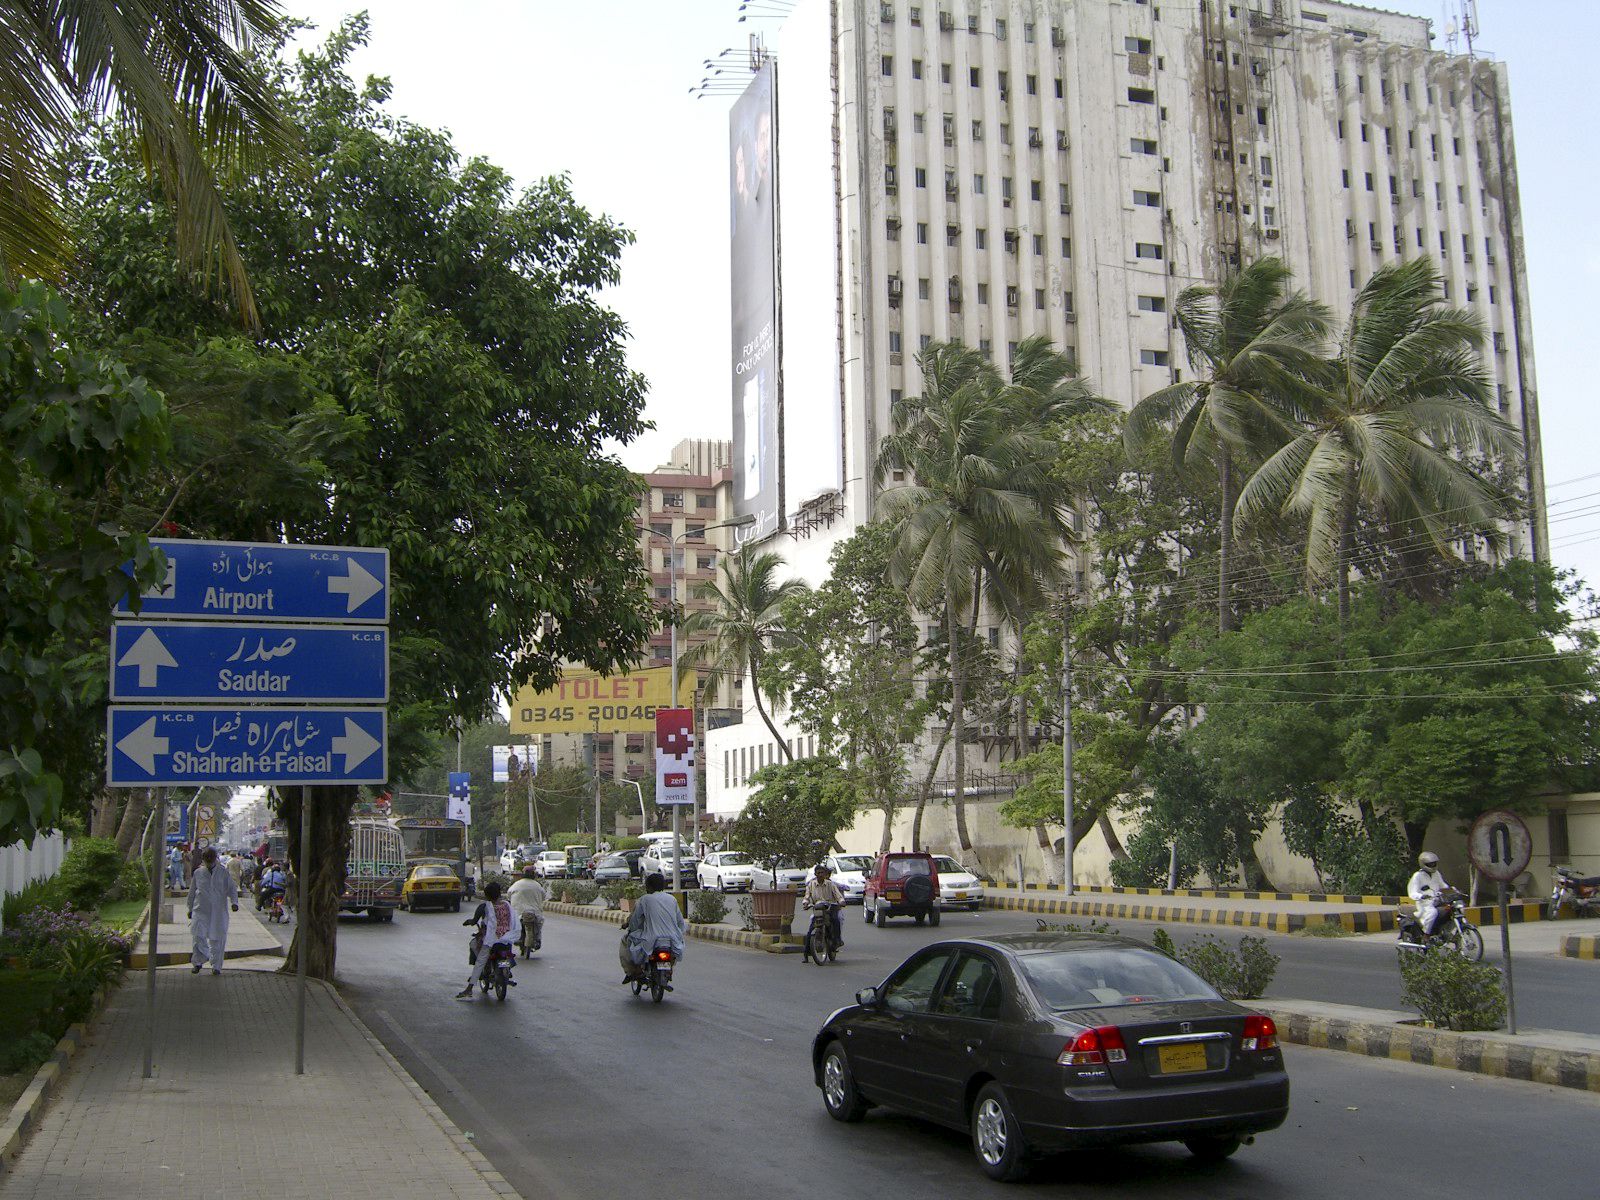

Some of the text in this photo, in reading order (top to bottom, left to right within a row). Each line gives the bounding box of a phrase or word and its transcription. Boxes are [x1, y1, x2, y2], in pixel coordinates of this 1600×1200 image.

[203, 587, 274, 614] Airport
[226, 637, 296, 662] صدر
[218, 668, 291, 692] Saddar
[172, 751, 332, 774] Shahrah-e-Faisal
